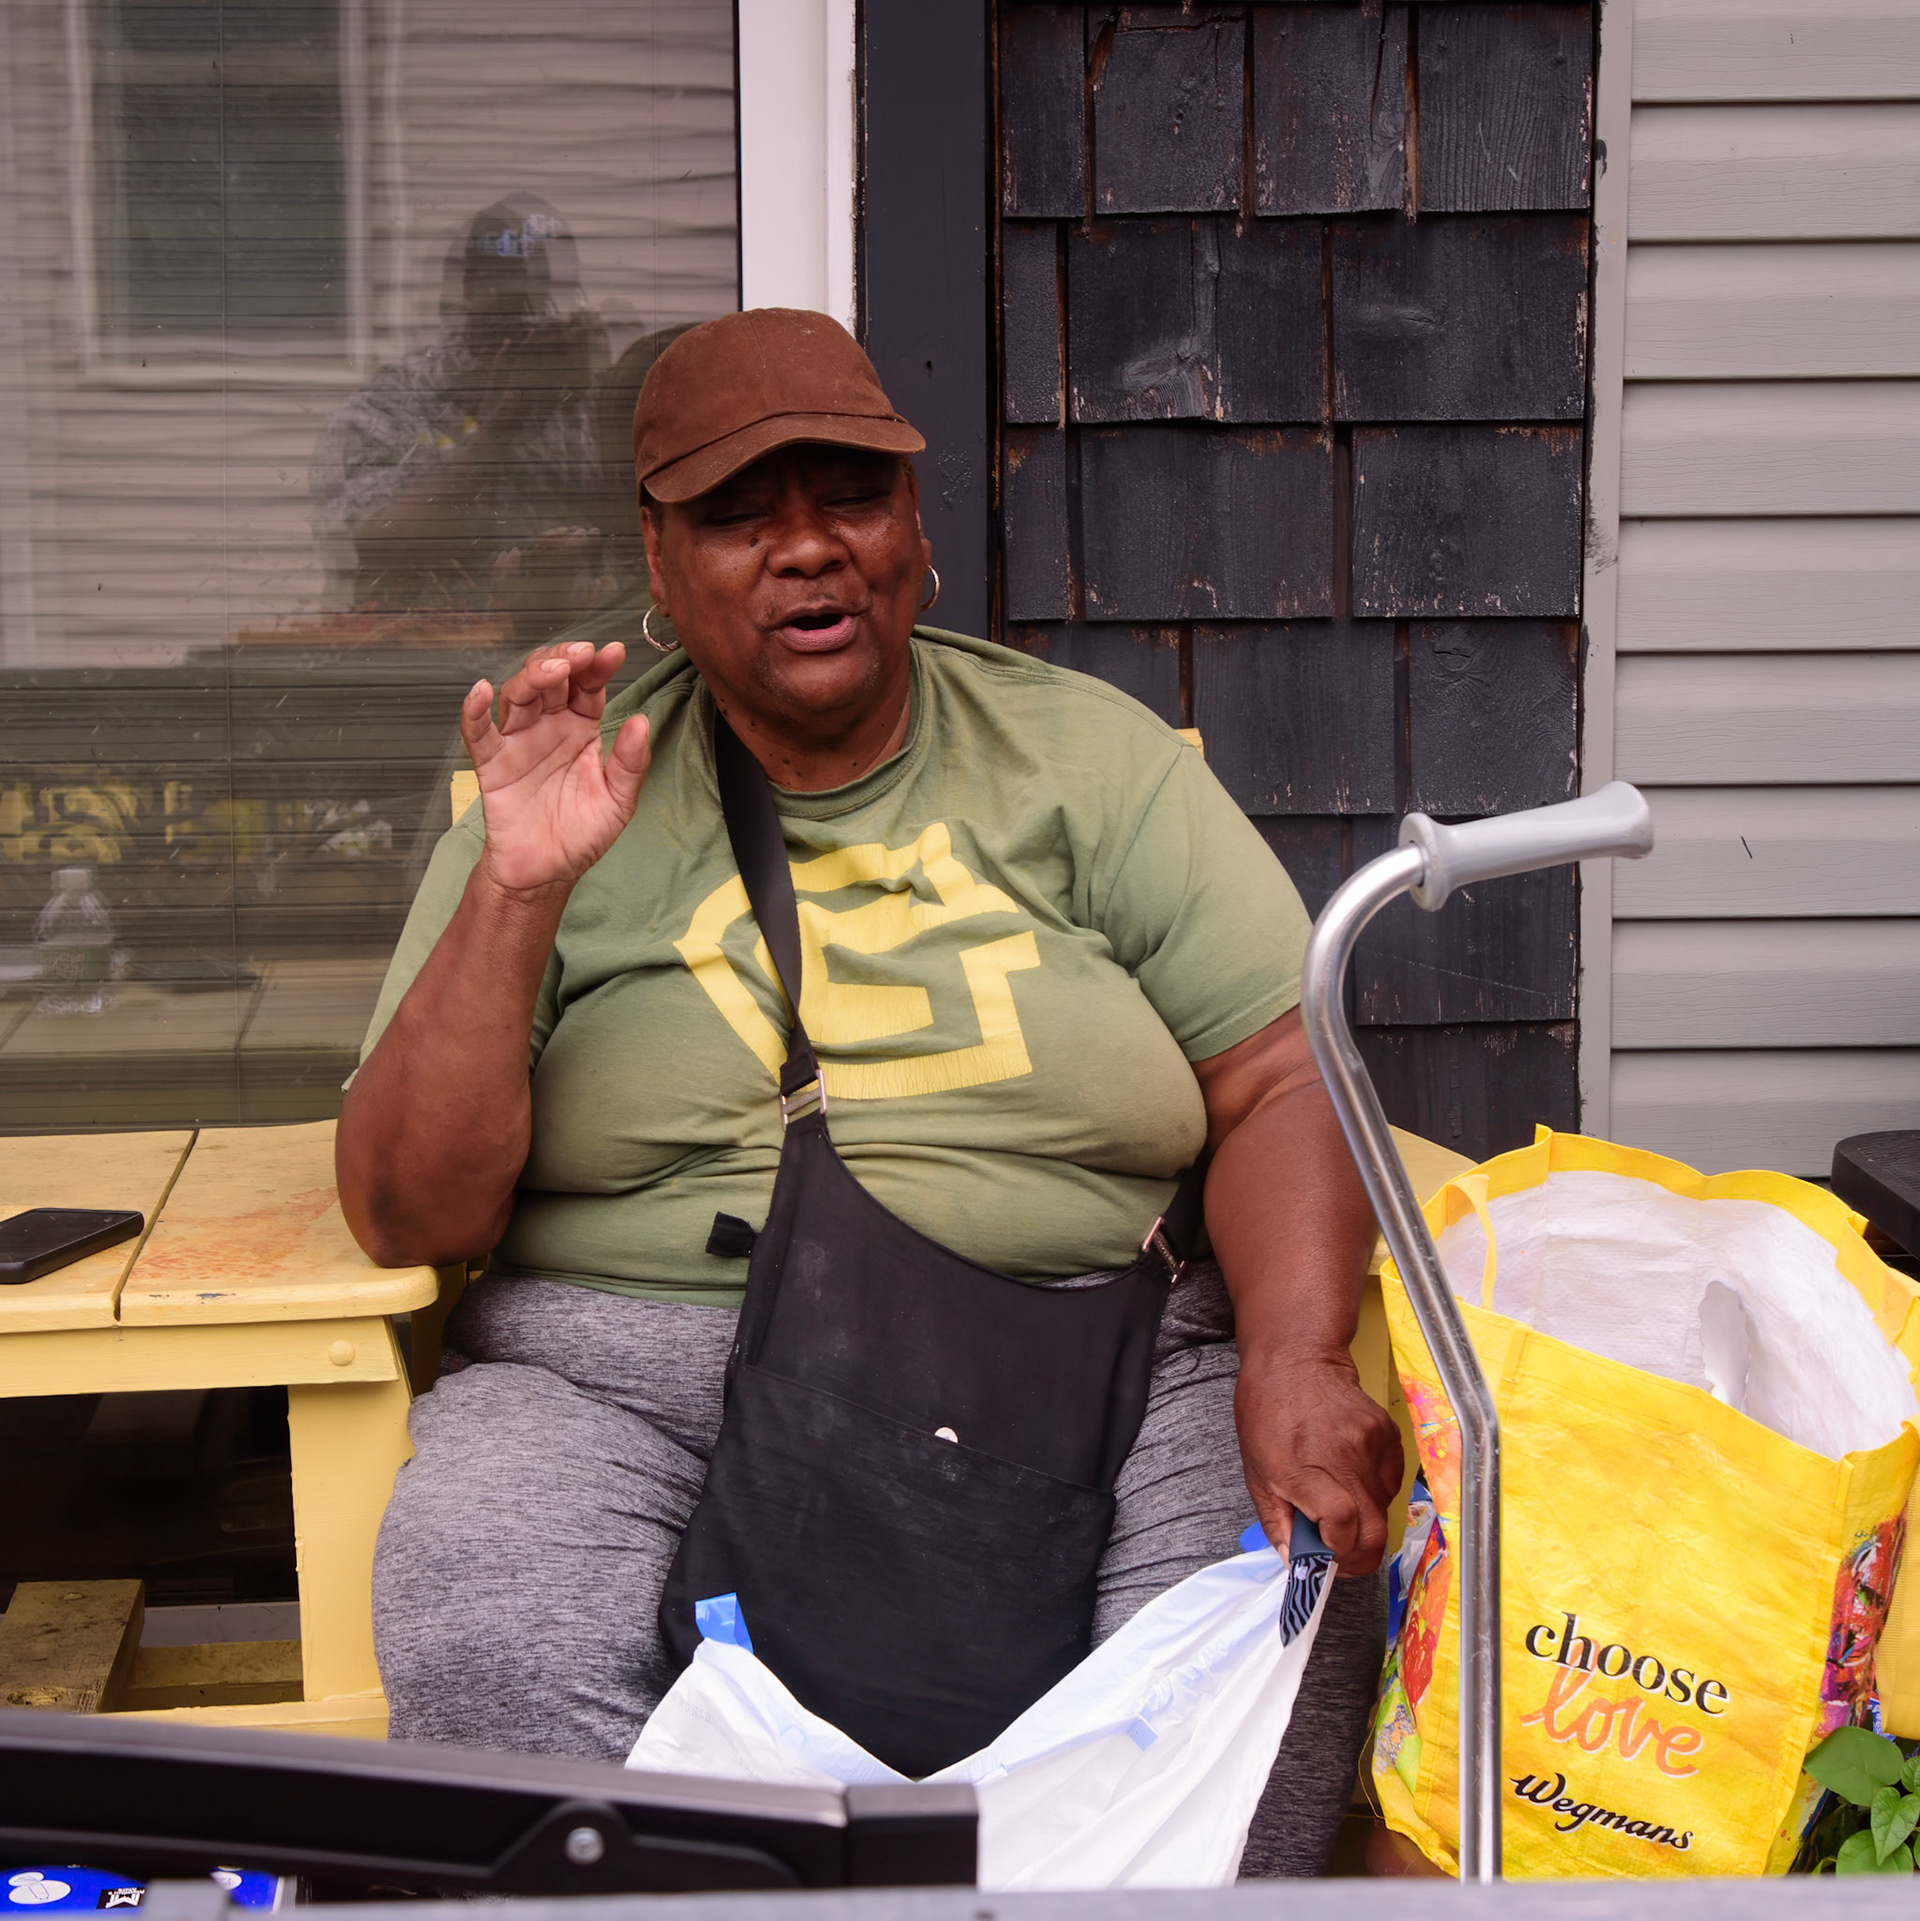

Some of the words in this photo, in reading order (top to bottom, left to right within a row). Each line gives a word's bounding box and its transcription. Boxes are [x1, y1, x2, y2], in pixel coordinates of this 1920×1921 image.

[1519, 1638, 1703, 1778] love
[1525, 1611, 1729, 1716] choose
[1509, 1772, 1694, 1850] Wegmans
